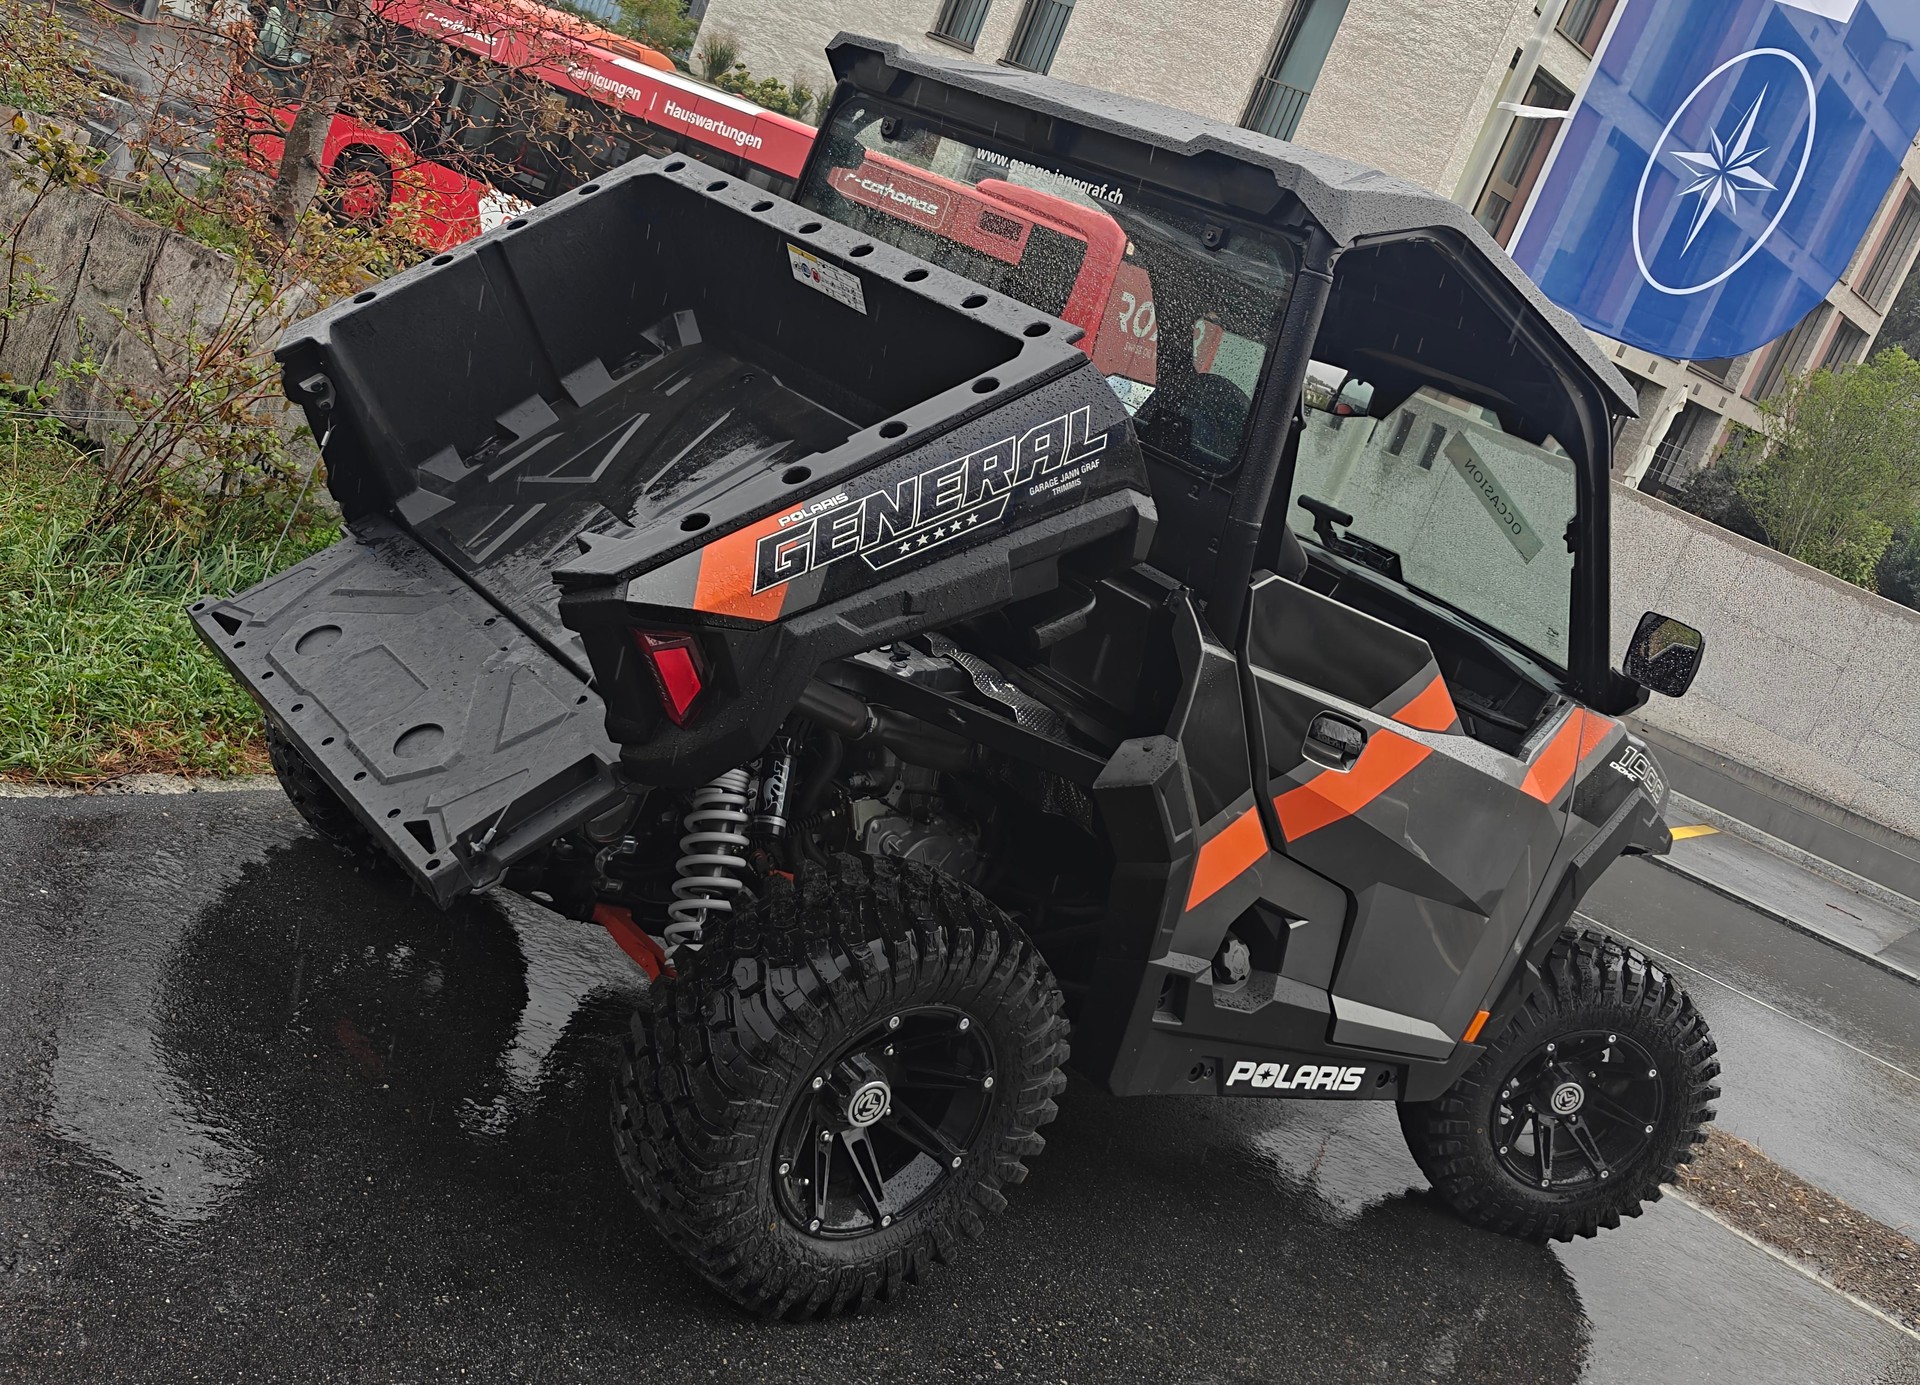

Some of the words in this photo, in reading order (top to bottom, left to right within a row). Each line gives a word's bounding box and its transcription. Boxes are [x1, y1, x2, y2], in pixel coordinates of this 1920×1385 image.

[664, 99, 763, 150] Hauswartungen
[976, 147, 1124, 205] www.garage-janngraf.ch
[1029, 476, 1059, 496] GARAGE
[1060, 467, 1080, 483] JANN
[1081, 458, 1100, 474] GRAF
[1052, 478, 1082, 496] TRIMMIS
[752, 404, 1109, 596] GENERAL
[778, 492, 849, 527] POLARIS
[763, 760, 789, 814] FOX
[1609, 761, 1638, 782] DOHC
[1226, 1061, 1367, 1092] POLARIS
